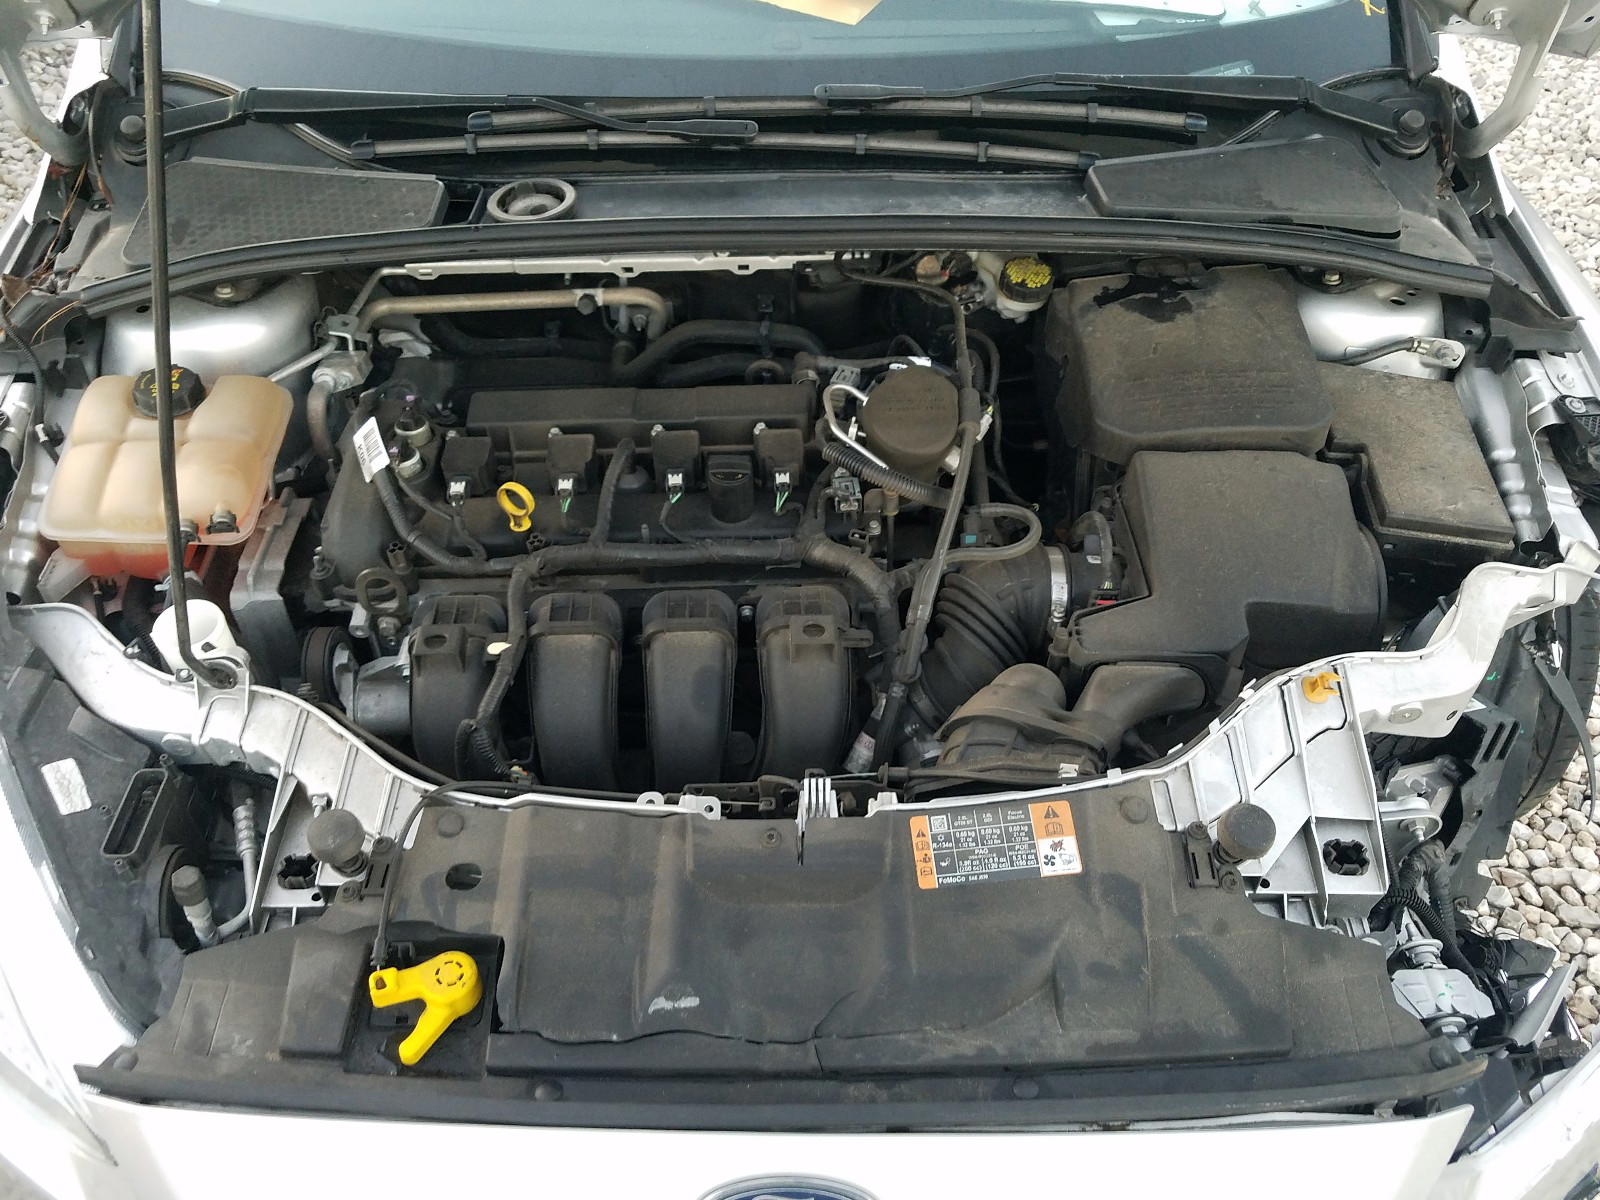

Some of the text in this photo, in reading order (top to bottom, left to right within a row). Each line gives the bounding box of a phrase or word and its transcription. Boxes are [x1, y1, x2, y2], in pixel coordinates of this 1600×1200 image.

[968, 830, 975, 838] kg
[932, 841, 952, 849] R-134a
[938, 875, 966, 884] FoMoCo
